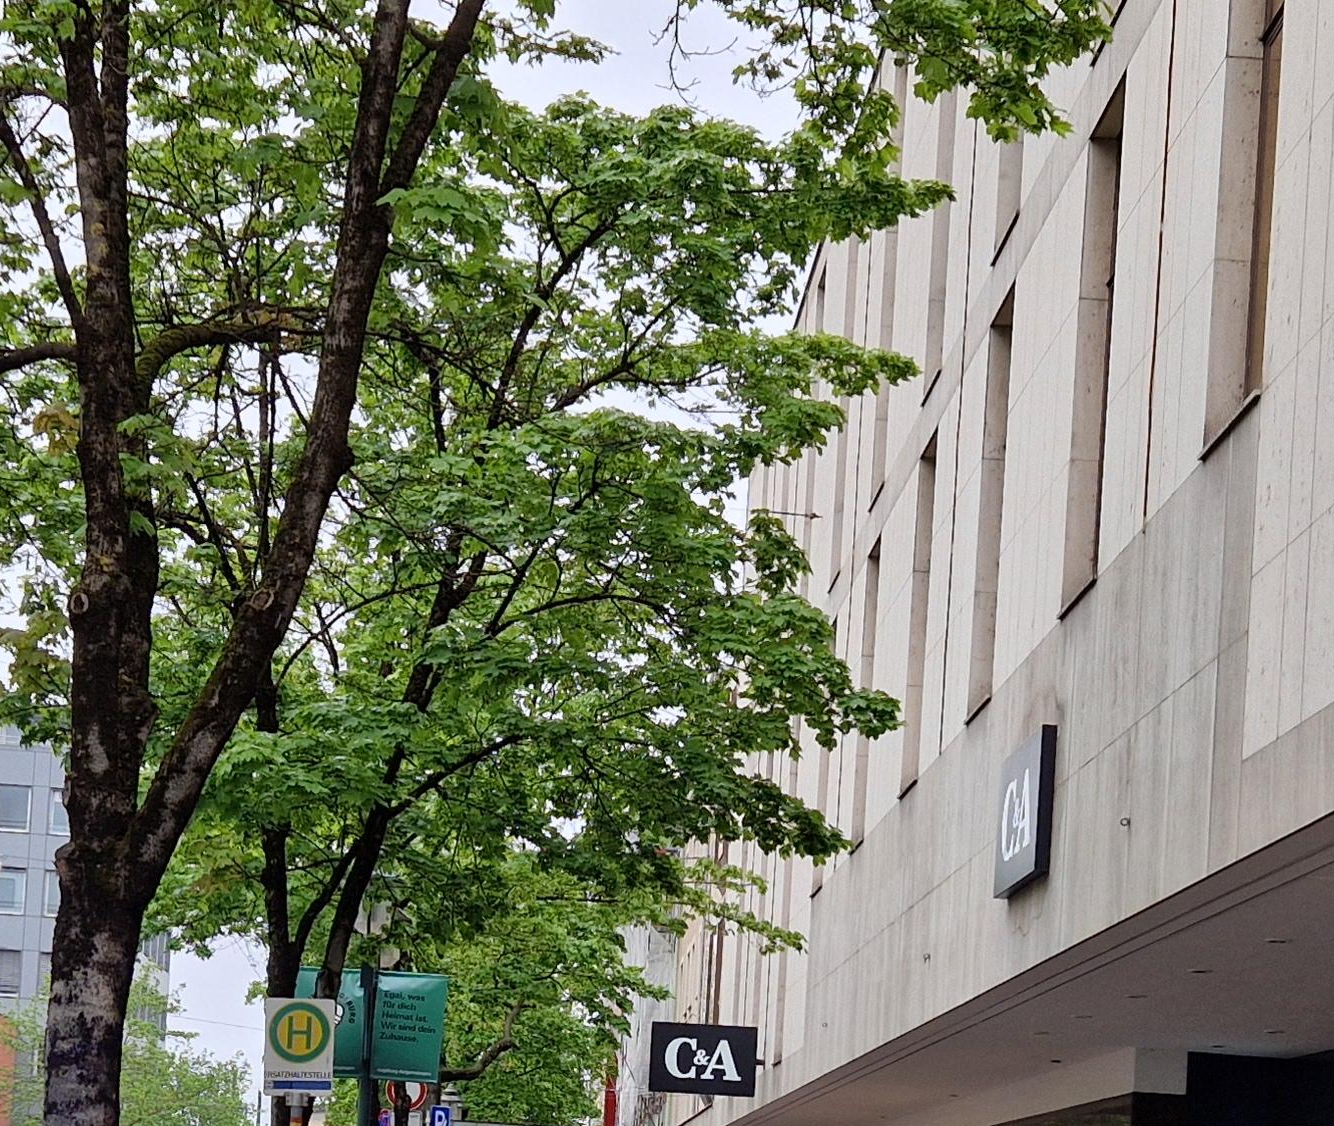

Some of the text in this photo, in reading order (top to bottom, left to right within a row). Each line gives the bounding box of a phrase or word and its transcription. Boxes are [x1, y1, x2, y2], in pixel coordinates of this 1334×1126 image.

[1001, 767, 1031, 862] C&A
[287, 1016, 312, 1049] H
[664, 1037, 742, 1081] C&A
